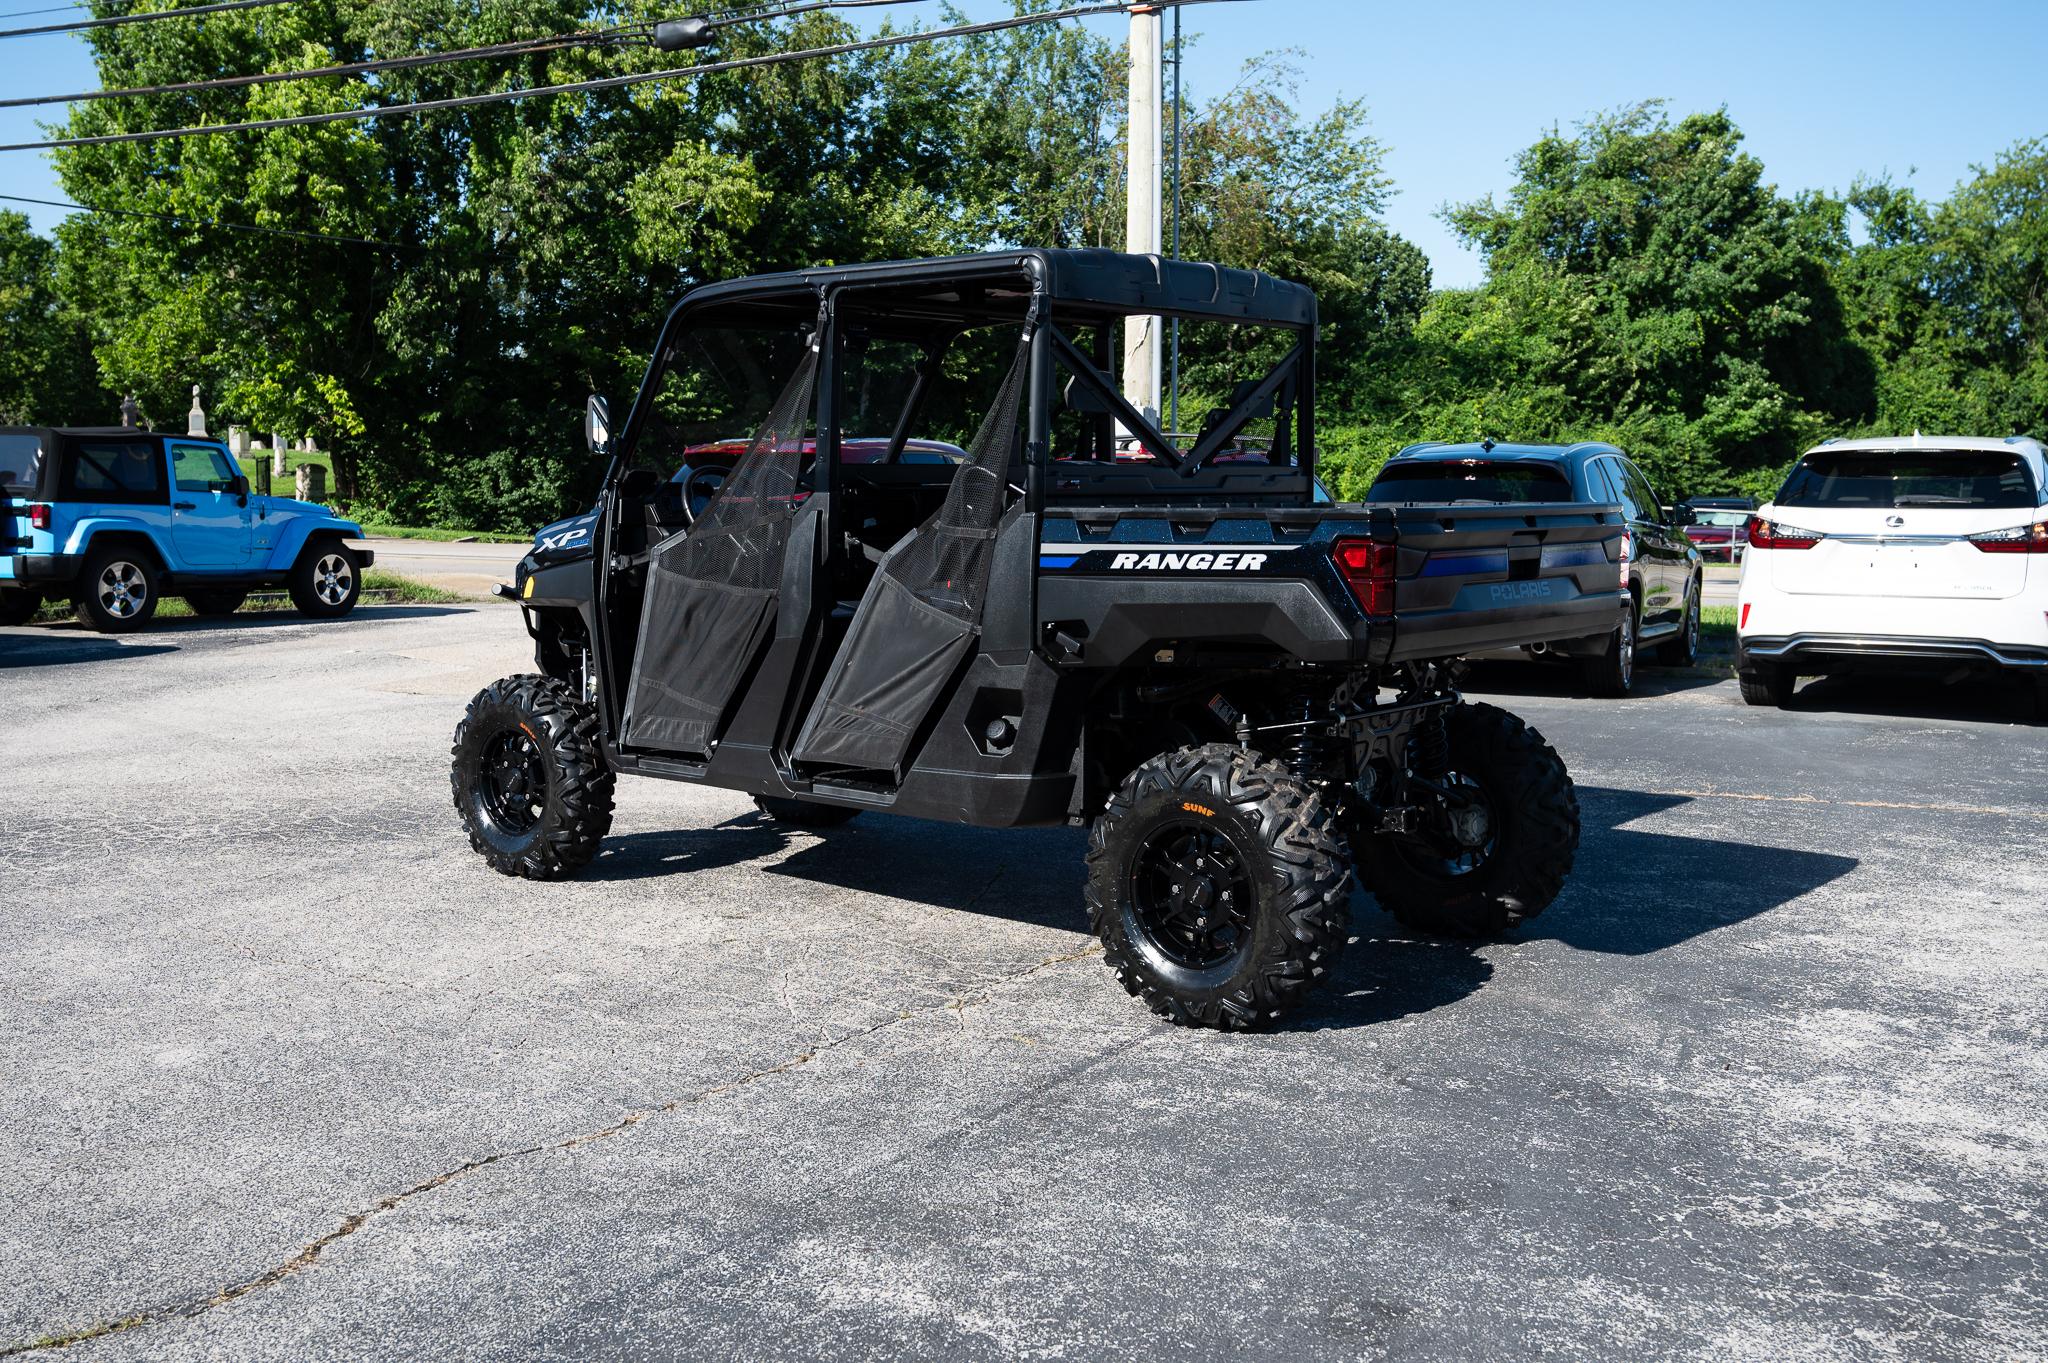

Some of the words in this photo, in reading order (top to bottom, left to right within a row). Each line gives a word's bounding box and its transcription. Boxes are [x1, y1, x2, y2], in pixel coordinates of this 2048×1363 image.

[535, 528, 588, 554] XP
[1109, 553, 1268, 570] RANGER
[1490, 581, 1552, 601] POLARIS
[1182, 802, 1216, 817] SUNF
